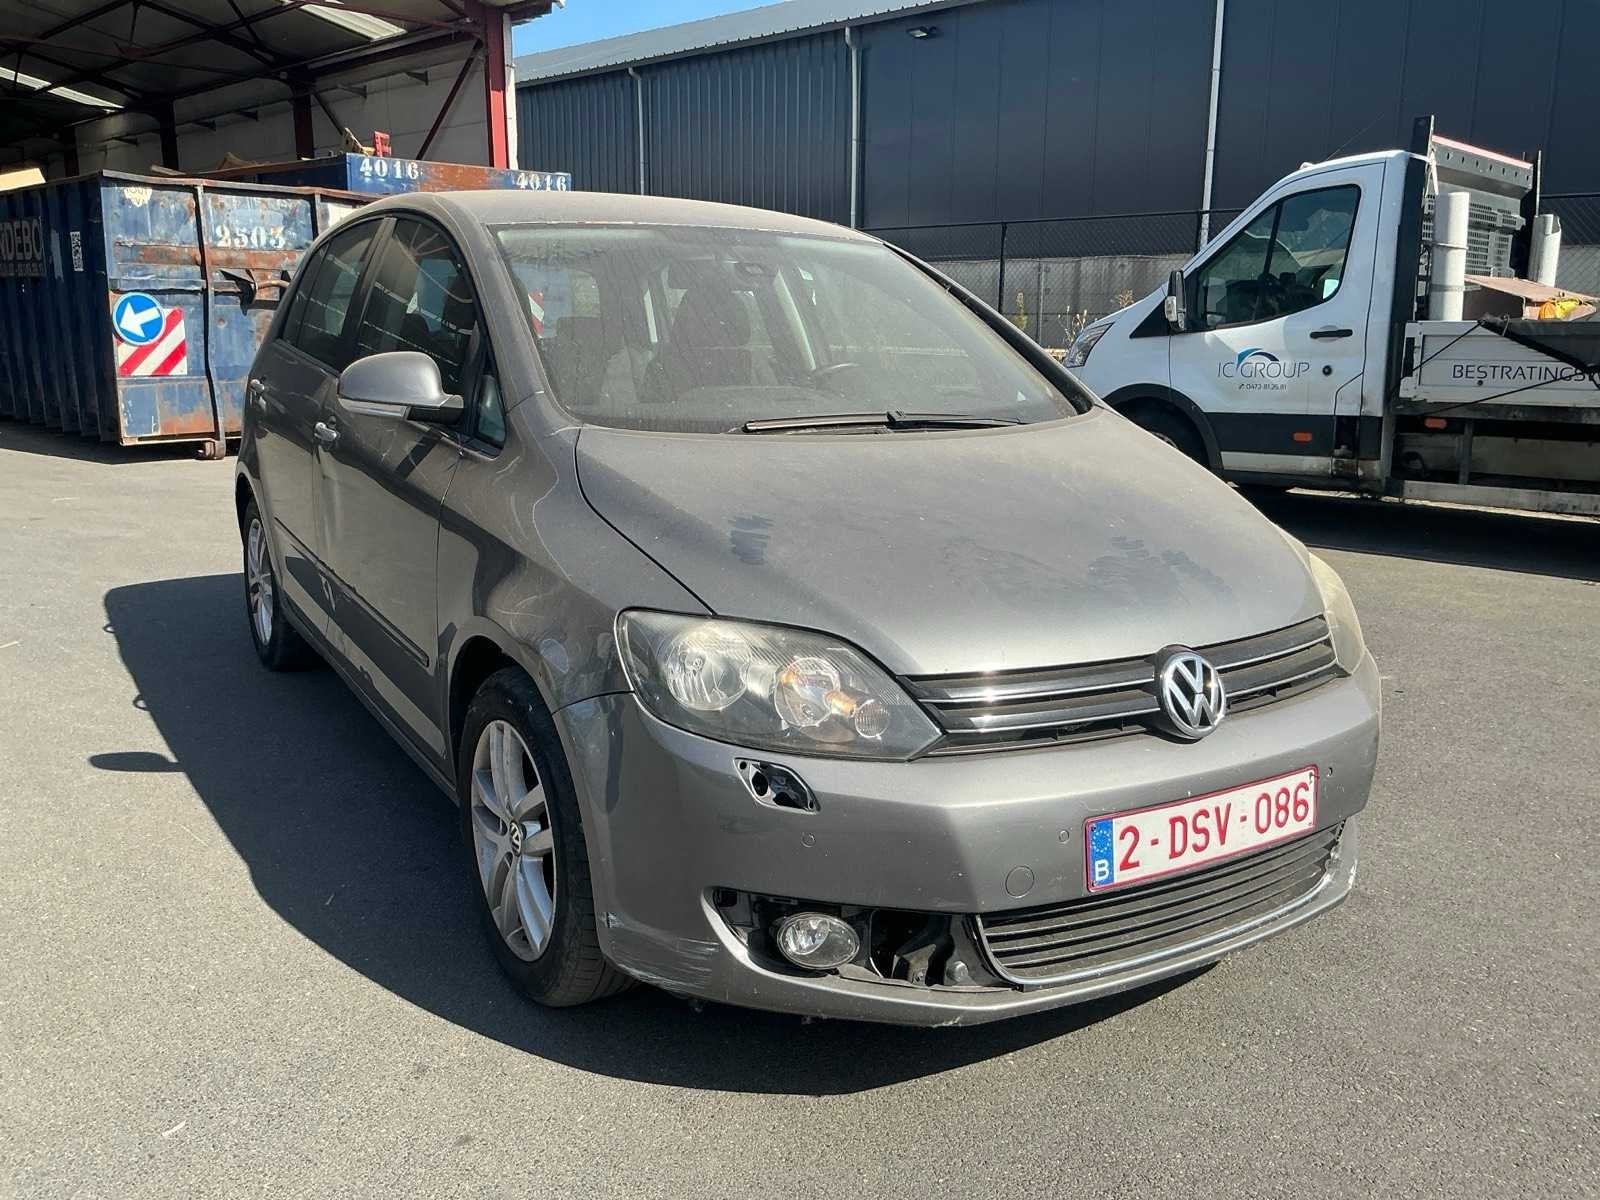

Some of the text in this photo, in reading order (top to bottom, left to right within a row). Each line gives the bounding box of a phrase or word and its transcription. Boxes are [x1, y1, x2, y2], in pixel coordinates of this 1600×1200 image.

[360, 159, 418, 180] 4016
[516, 172, 567, 192] 4016
[216, 225, 286, 249] 2503
[1217, 361, 1310, 378] IC GROUP
[1094, 859, 1110, 881] B
